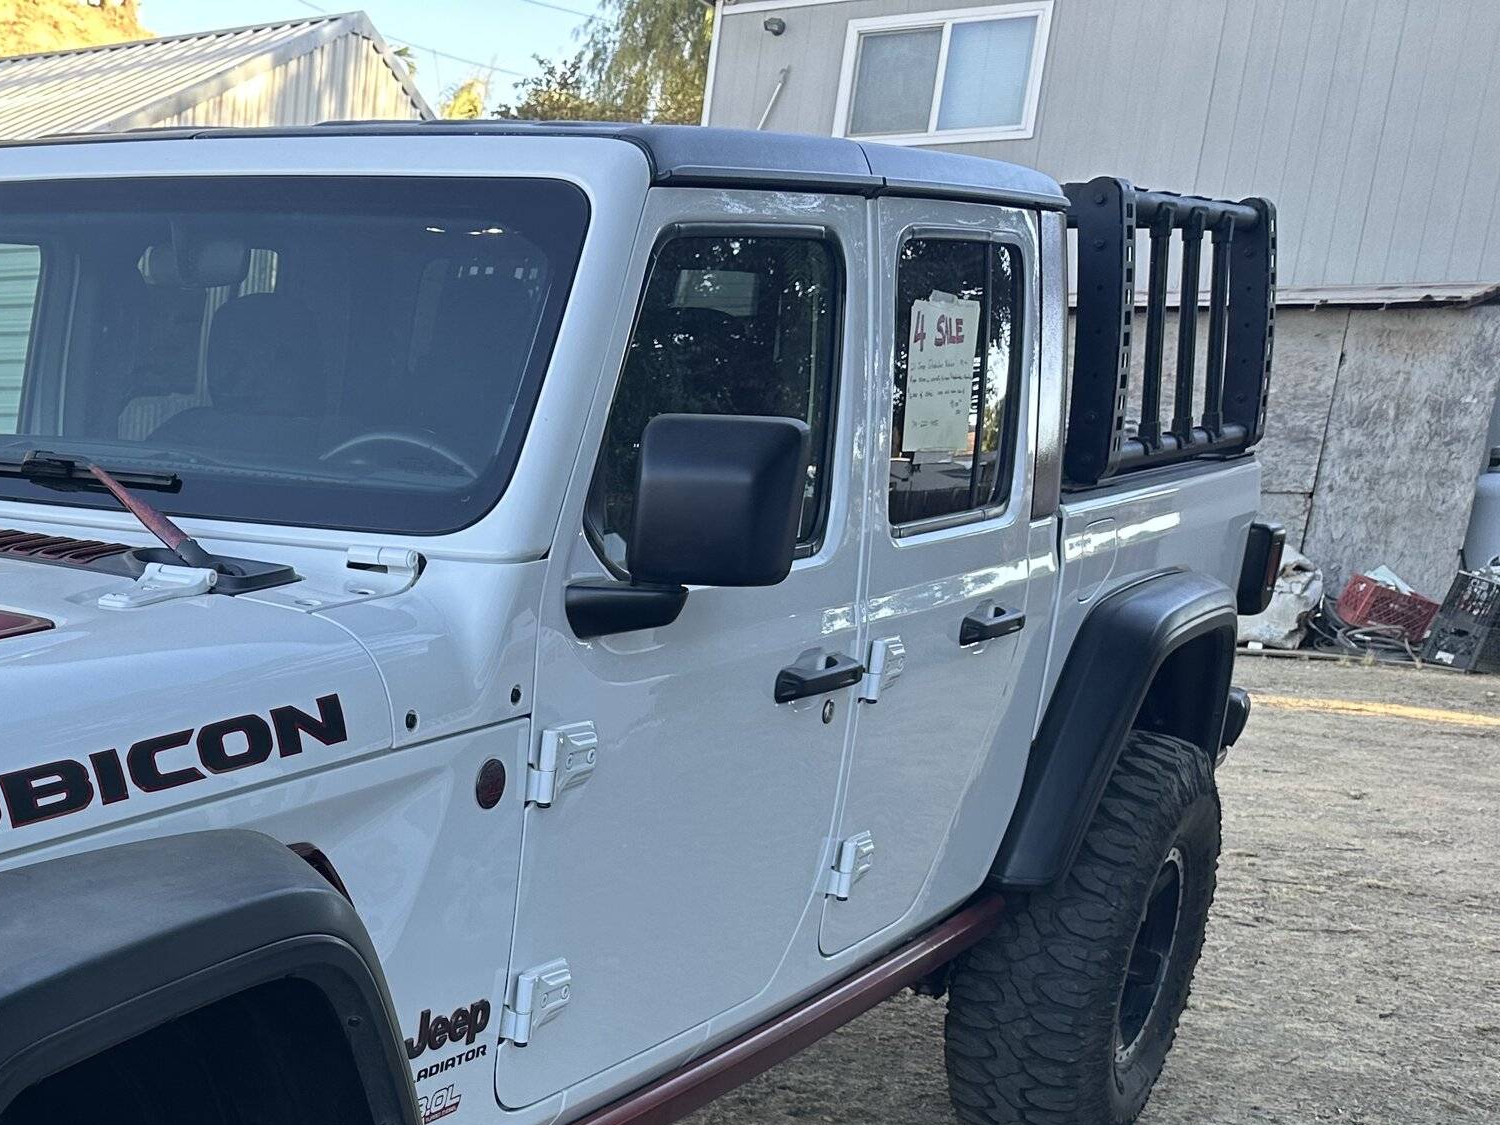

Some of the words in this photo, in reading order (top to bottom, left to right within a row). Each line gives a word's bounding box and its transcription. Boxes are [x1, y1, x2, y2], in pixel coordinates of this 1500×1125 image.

[913, 311, 926, 352] 4
[934, 313, 964, 347] SALE
[404, 999, 491, 1060] Jeep
[413, 1044, 487, 1084] ADIATOR
